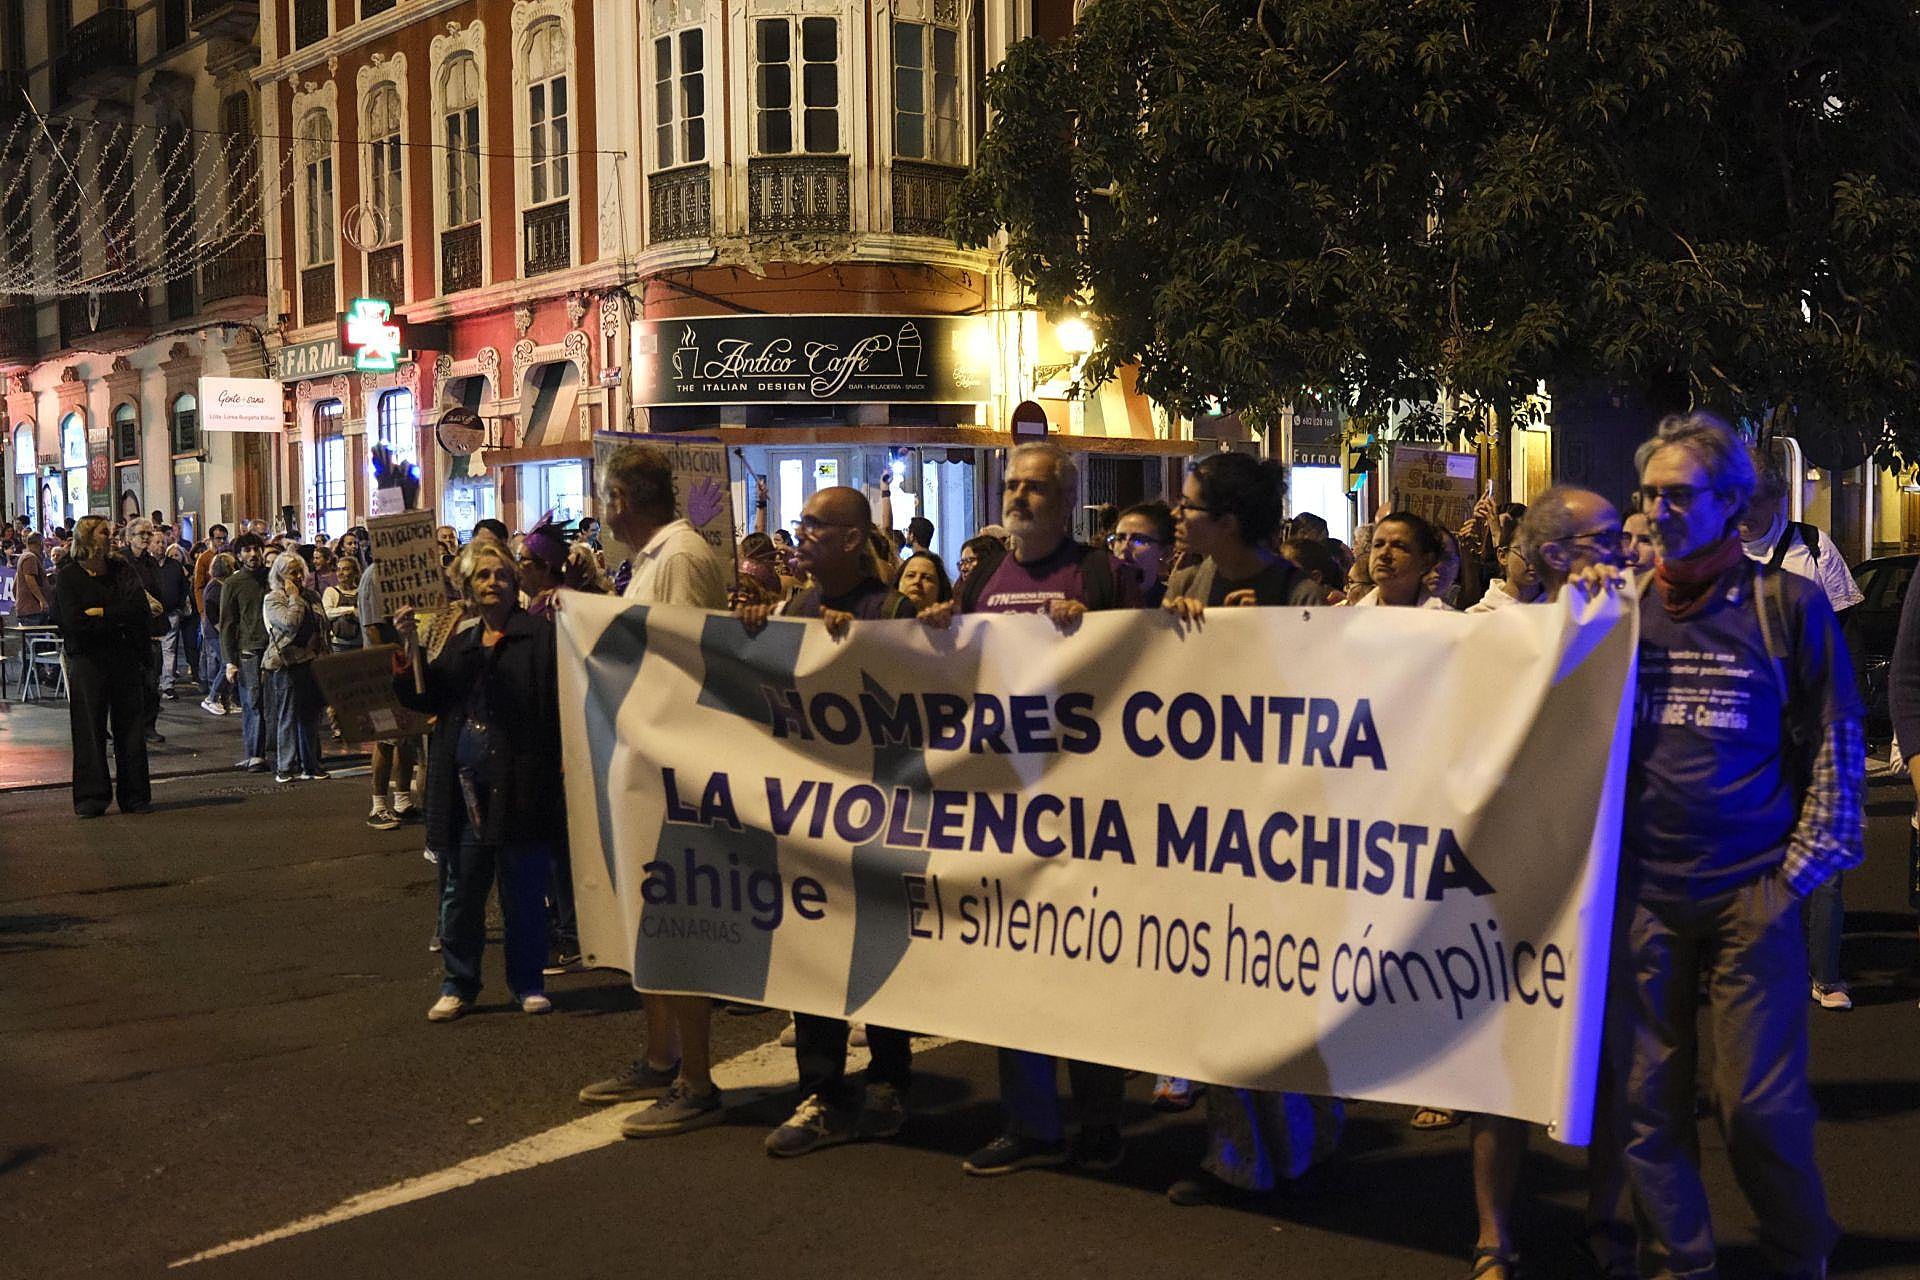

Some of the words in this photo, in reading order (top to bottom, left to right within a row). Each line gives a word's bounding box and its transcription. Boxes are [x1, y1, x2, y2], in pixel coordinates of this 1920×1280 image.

[676, 384, 695, 392] THE
[702, 383, 748, 392] ITALIAN
[758, 383, 806, 391] DESIGN
[704, 338, 797, 379] Antico
[762, 670, 1101, 754] HOMBRES
[1122, 691, 1388, 771] CONTRA
[661, 767, 745, 831] LA
[764, 776, 1136, 865] VIOLENCIA
[1156, 802, 1496, 901] MACHISTA
[641, 847, 828, 931] ahige
[642, 913, 742, 945] CANARIAS
[903, 873, 944, 940] El
[959, 875, 1123, 961] silencio
[1137, 913, 1211, 978] nos
[1225, 903, 1320, 997] hace
[1332, 918, 1571, 1021] cómplice
